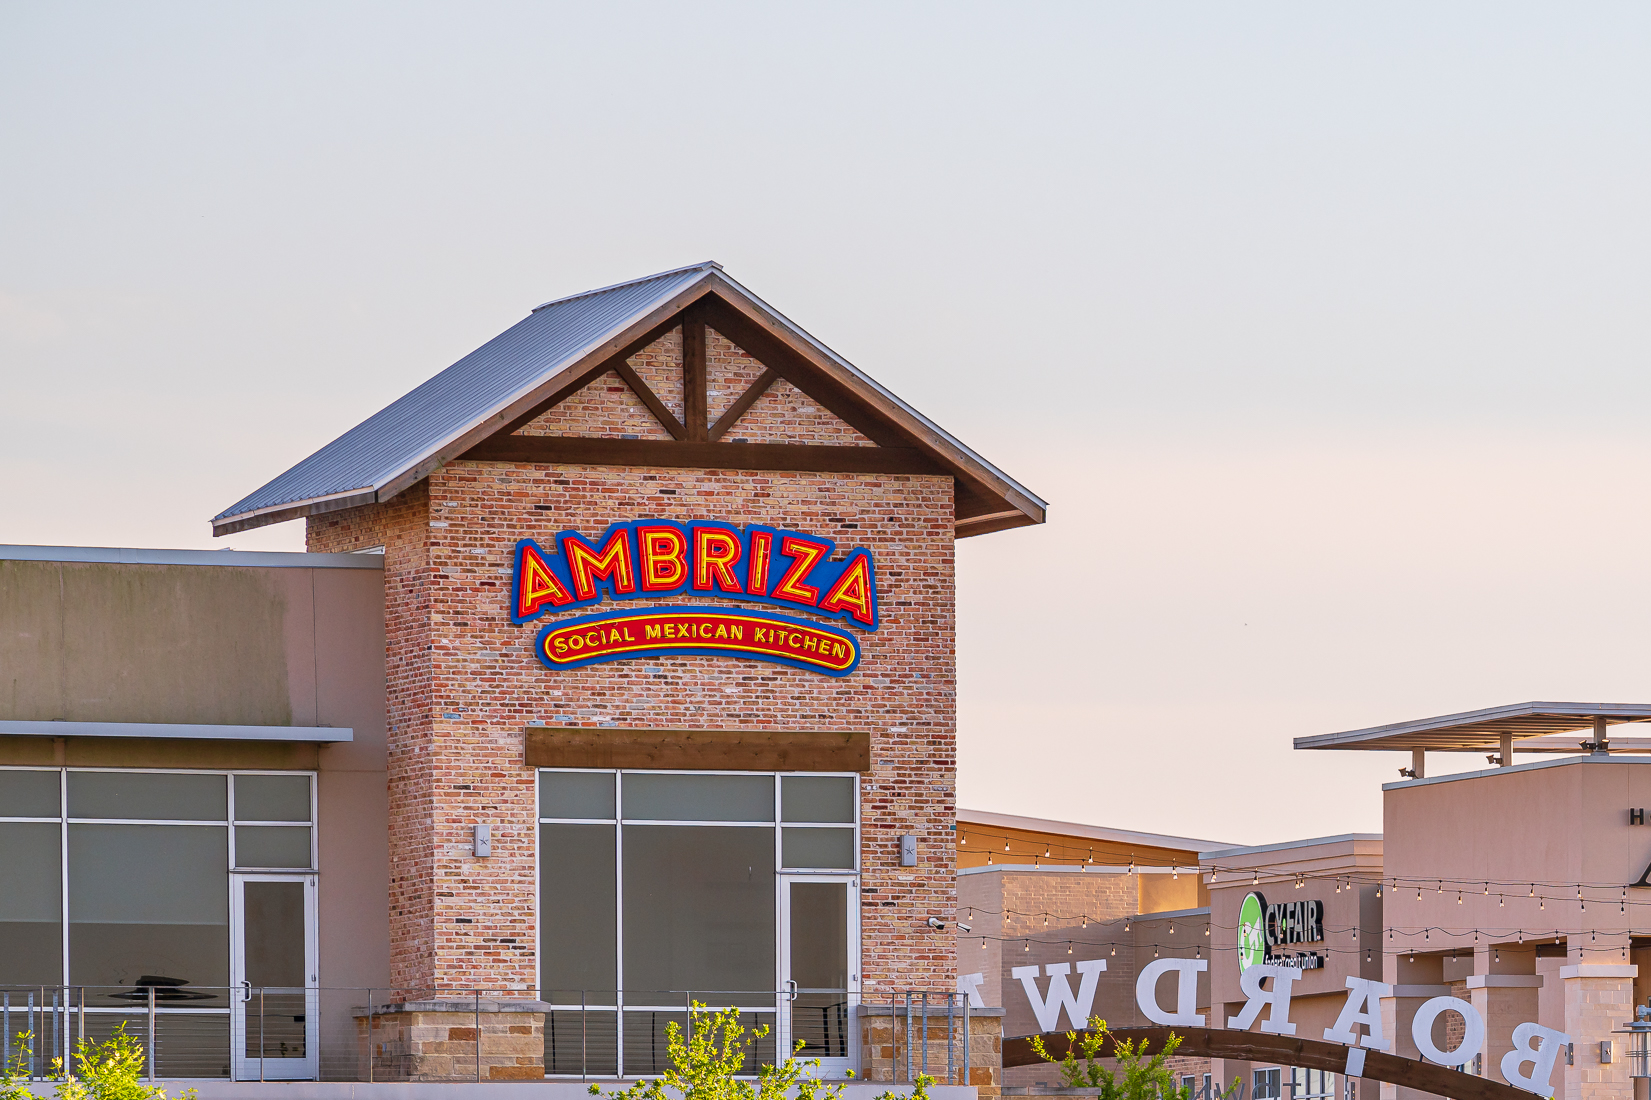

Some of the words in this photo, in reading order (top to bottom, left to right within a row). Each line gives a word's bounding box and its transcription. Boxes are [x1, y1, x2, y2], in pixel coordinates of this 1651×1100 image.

[517, 524, 875, 627] AMBRIZA
[553, 626, 636, 656] SOCIAL
[645, 622, 744, 641] MEXICAN
[754, 627, 847, 659] KITCHEN
[1301, 952, 1318, 970] union
